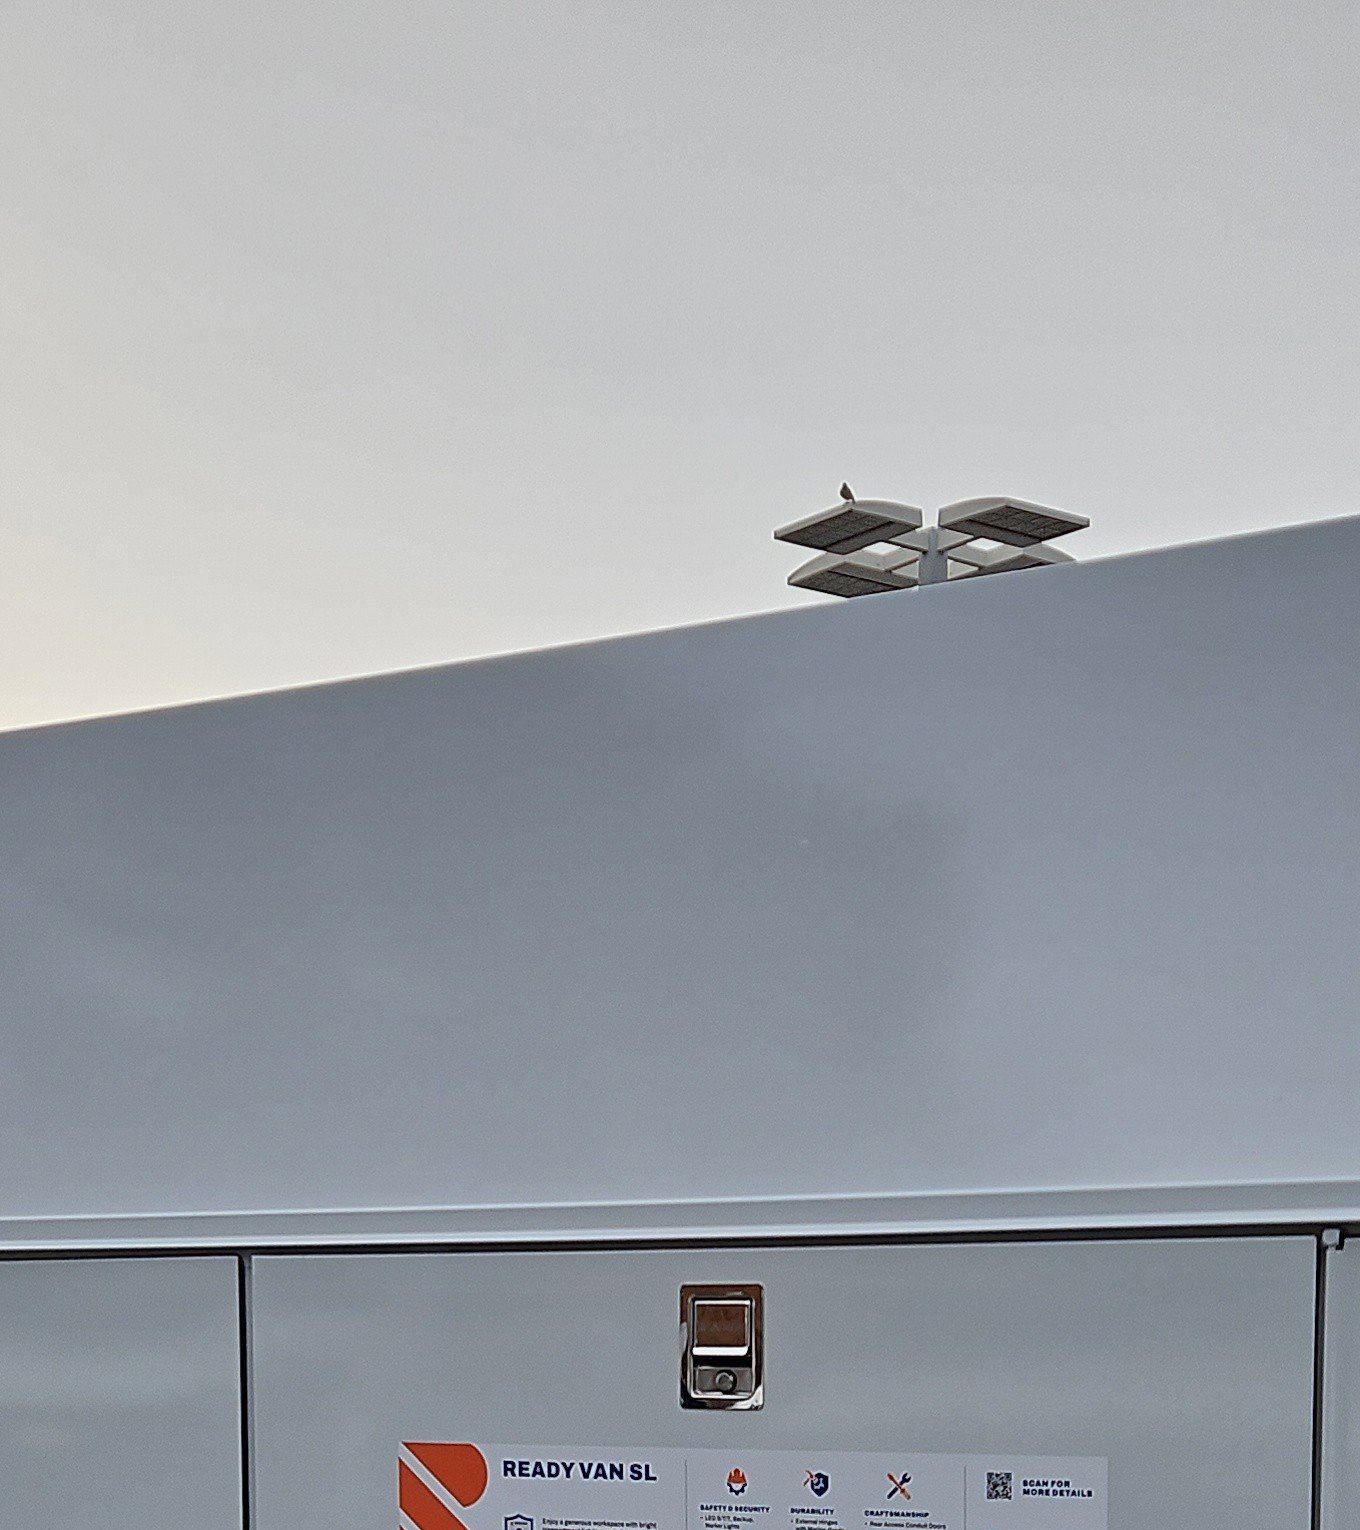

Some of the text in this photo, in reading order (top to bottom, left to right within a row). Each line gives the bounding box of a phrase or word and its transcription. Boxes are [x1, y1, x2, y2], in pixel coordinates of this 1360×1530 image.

[503, 1461, 657, 1481] READY VAN SL
[543, 1518, 558, 1526] Enjoy
